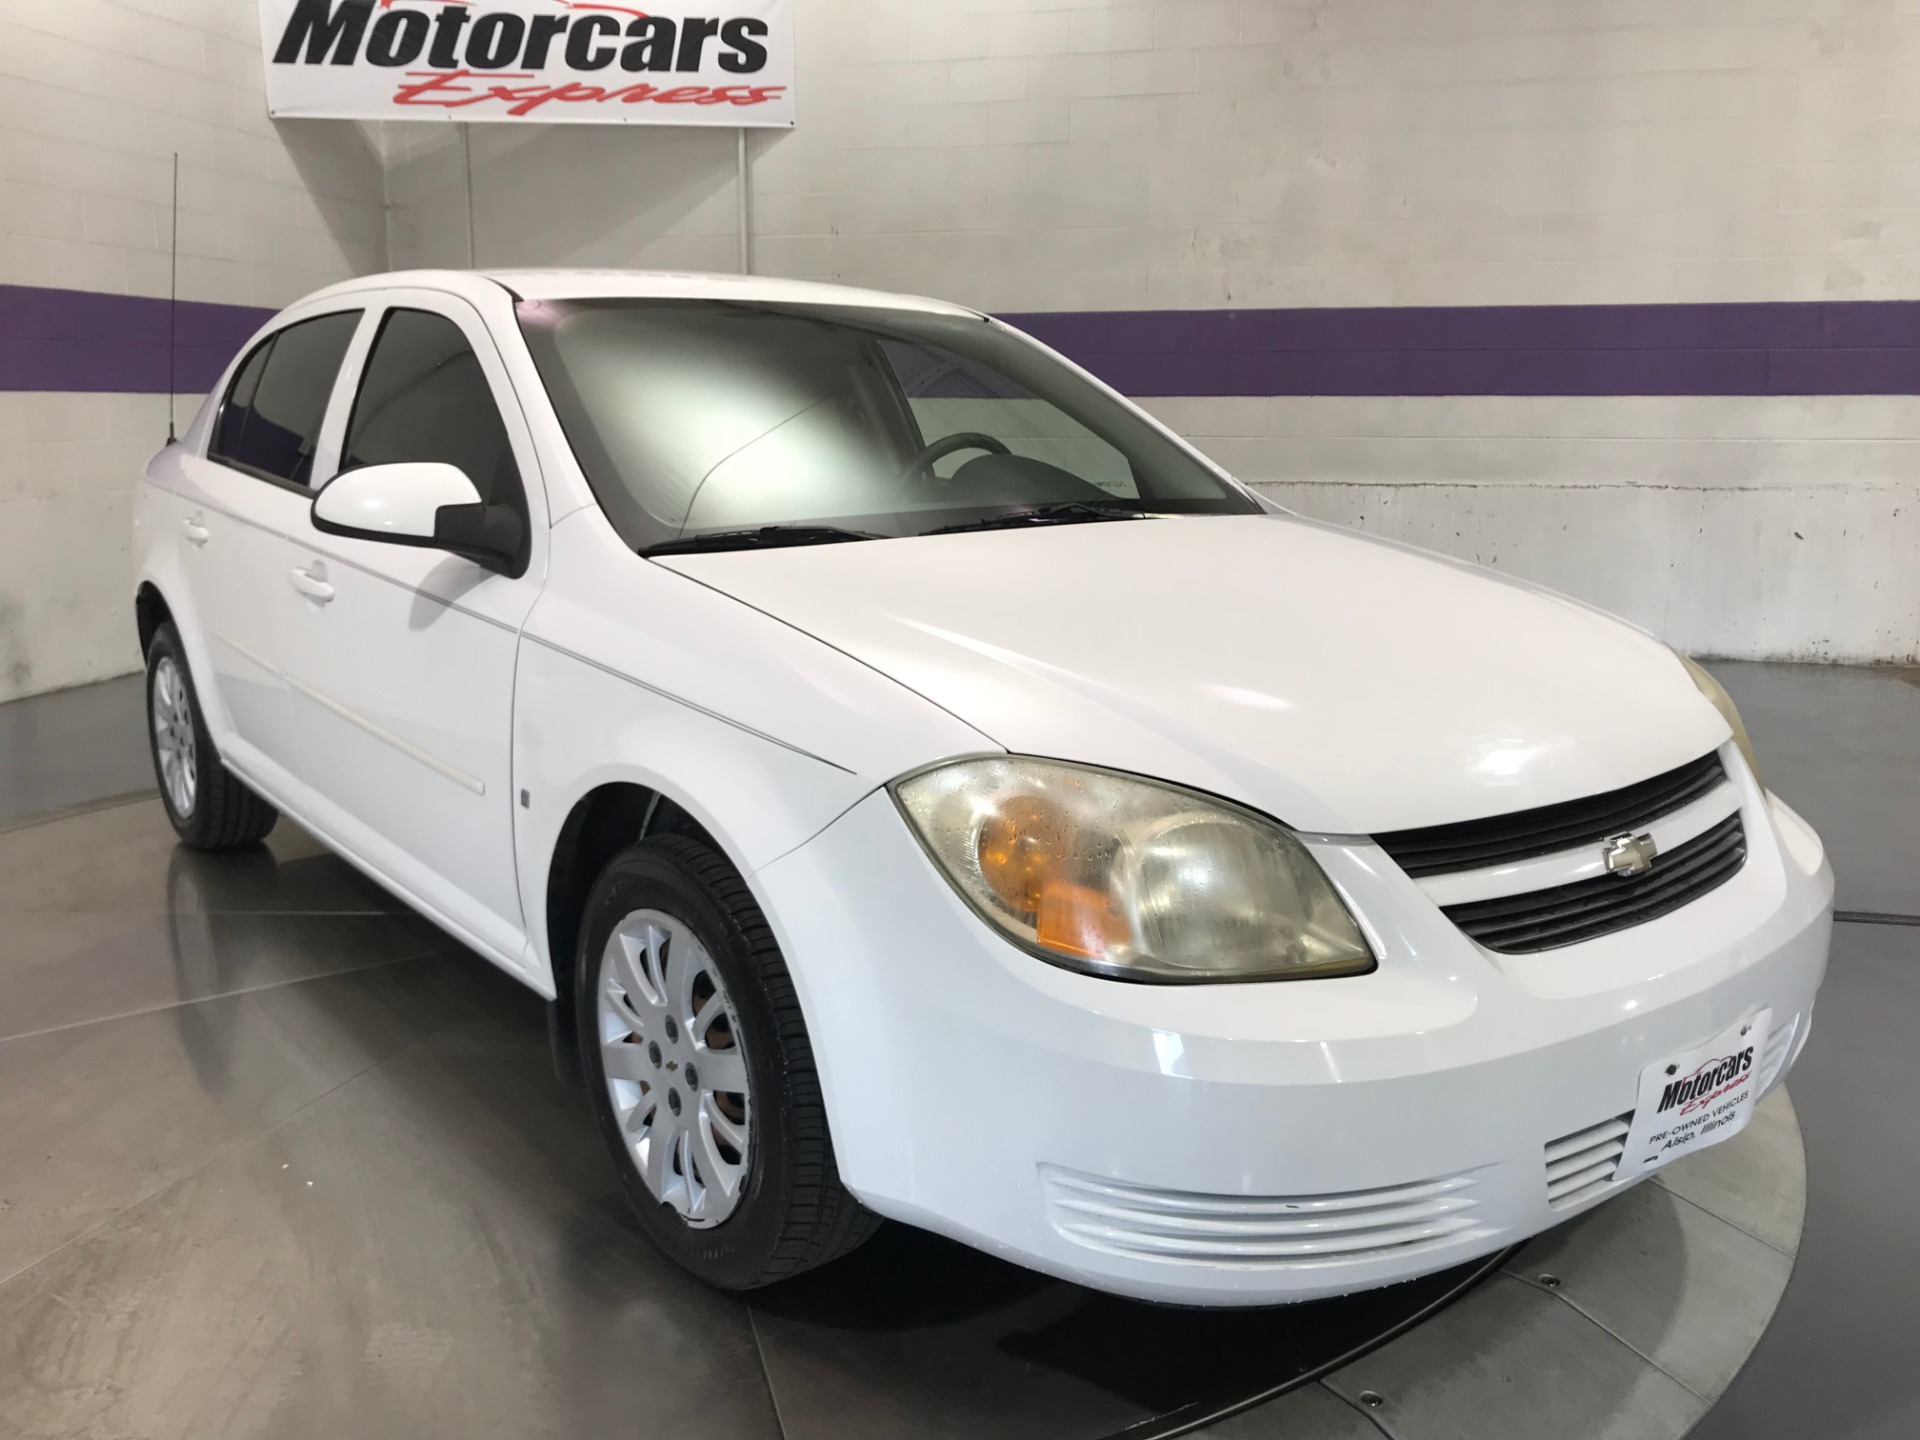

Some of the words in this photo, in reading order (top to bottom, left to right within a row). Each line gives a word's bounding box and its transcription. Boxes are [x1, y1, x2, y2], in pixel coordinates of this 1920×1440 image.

[273, 0, 769, 73] Motorcars
[392, 70, 787, 115] Express
[1656, 1046, 1754, 1114] Motorcars
[1679, 1072, 1751, 1116] Express
[1649, 1113, 1710, 1144] PRE-OWNED
[1712, 1090, 1749, 1117] VEHICLES
[1661, 1130, 1696, 1151] Alsip,
[1700, 1110, 1736, 1135] Illinois
